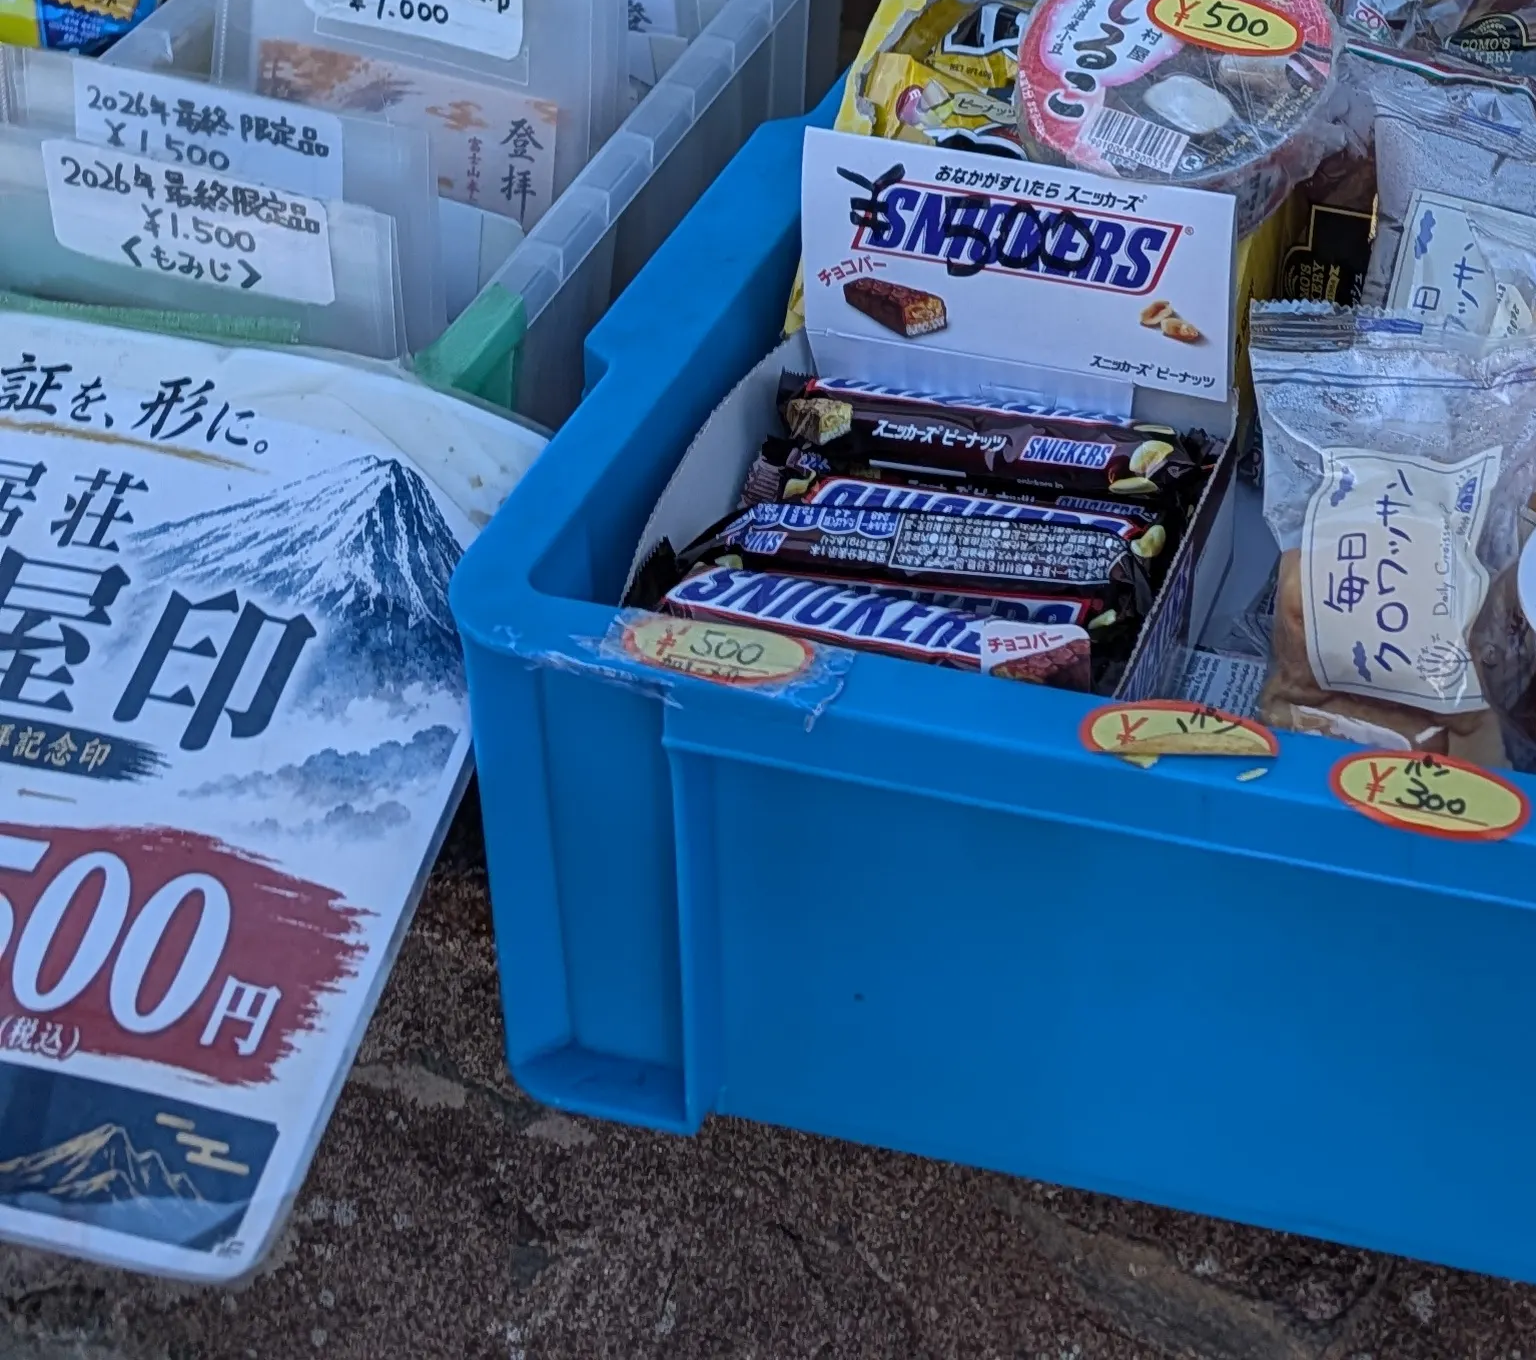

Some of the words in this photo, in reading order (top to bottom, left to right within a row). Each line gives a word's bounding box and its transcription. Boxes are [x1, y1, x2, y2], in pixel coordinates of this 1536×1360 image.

[1460, 35, 1512, 53] COMO'S
[934, 164, 1062, 198] おなかがすいたら
[817, 255, 888, 288] チョコバー
[1156, 365, 1216, 388] ピーナッツ
[941, 426, 1008, 453] ピーナッツ
[1023, 436, 1114, 469] SNICKERS
[1324, 531, 1368, 613] 毎日
[1374, 468, 1415, 674] クロワッサン
[987, 629, 1065, 656] チョコバー
[1366, 760, 1467, 816] ¥300
